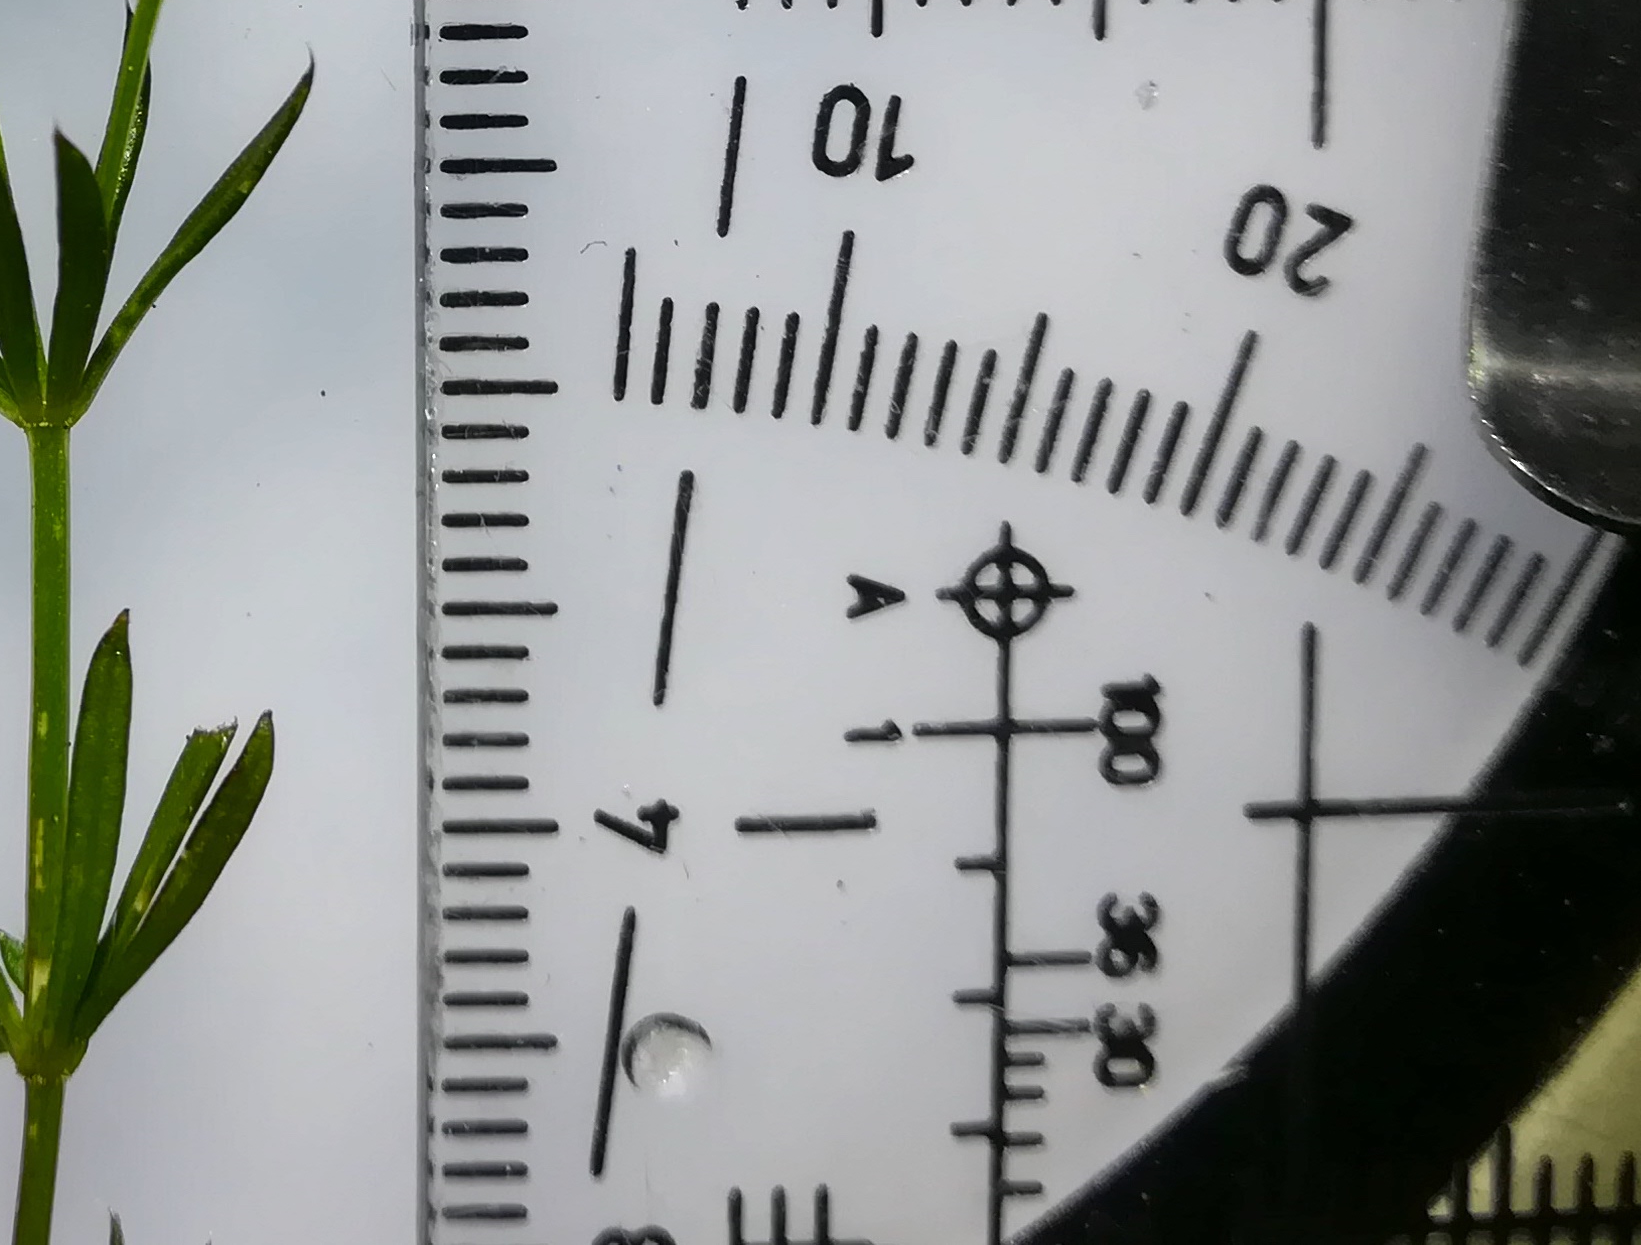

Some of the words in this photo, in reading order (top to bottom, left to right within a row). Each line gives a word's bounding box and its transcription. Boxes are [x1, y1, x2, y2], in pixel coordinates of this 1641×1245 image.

[812, 83, 914, 182] 10
[1225, 185, 1352, 297] 20
[847, 574, 906, 619] A
[1097, 674, 1161, 786] 100
[594, 800, 680, 854] 4
[1095, 1004, 1157, 1089] 30
